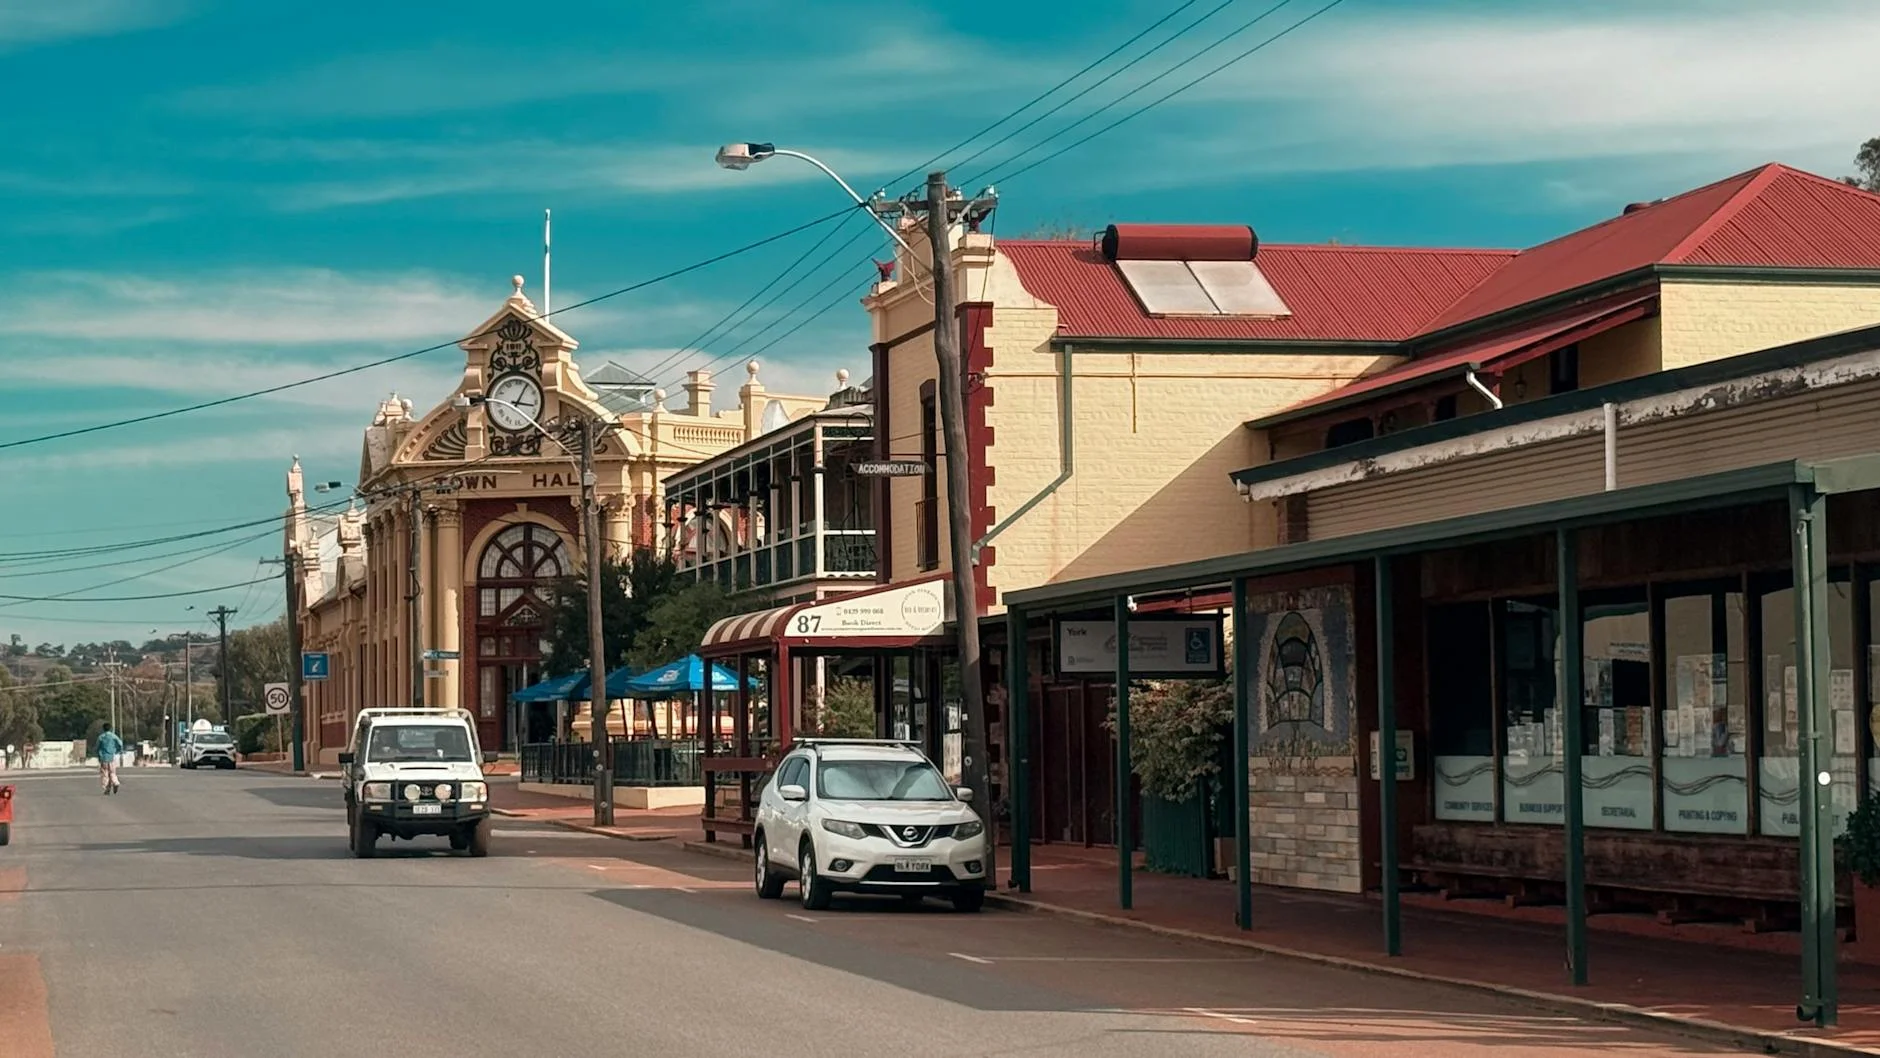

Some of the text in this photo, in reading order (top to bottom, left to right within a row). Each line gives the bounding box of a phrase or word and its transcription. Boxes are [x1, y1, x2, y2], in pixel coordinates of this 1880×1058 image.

[858, 464, 925, 474] ACCOMMODATION
[532, 472, 580, 487] HAL
[797, 615, 821, 633] 87
[1067, 628, 1087, 637] York
[270, 693, 285, 704] 50
